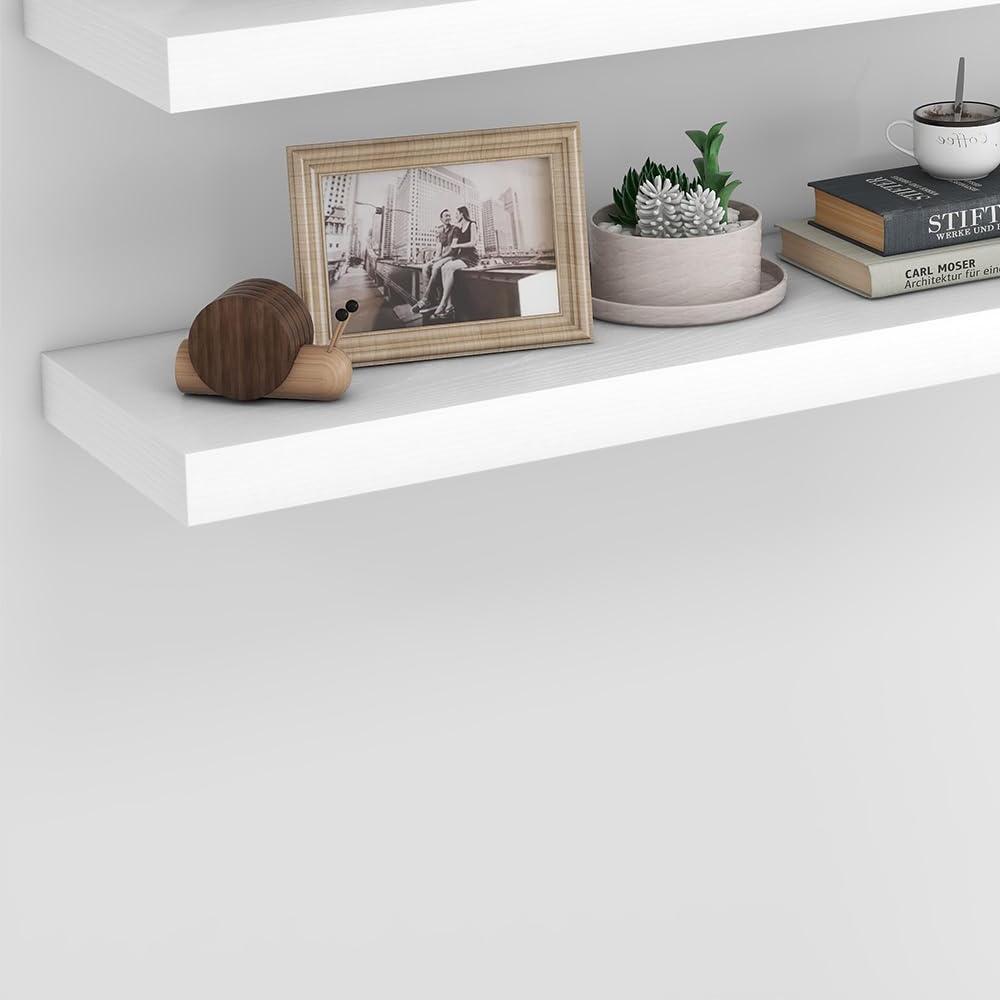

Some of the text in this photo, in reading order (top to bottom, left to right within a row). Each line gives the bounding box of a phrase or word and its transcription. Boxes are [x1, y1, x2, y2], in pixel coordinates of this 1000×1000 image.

[936, 229, 971, 241] WERKE
[973, 224, 995, 234] UND
[904, 271, 962, 289] Architektur
[965, 268, 981, 279] für
[905, 258, 976, 279] CARL MOSER
